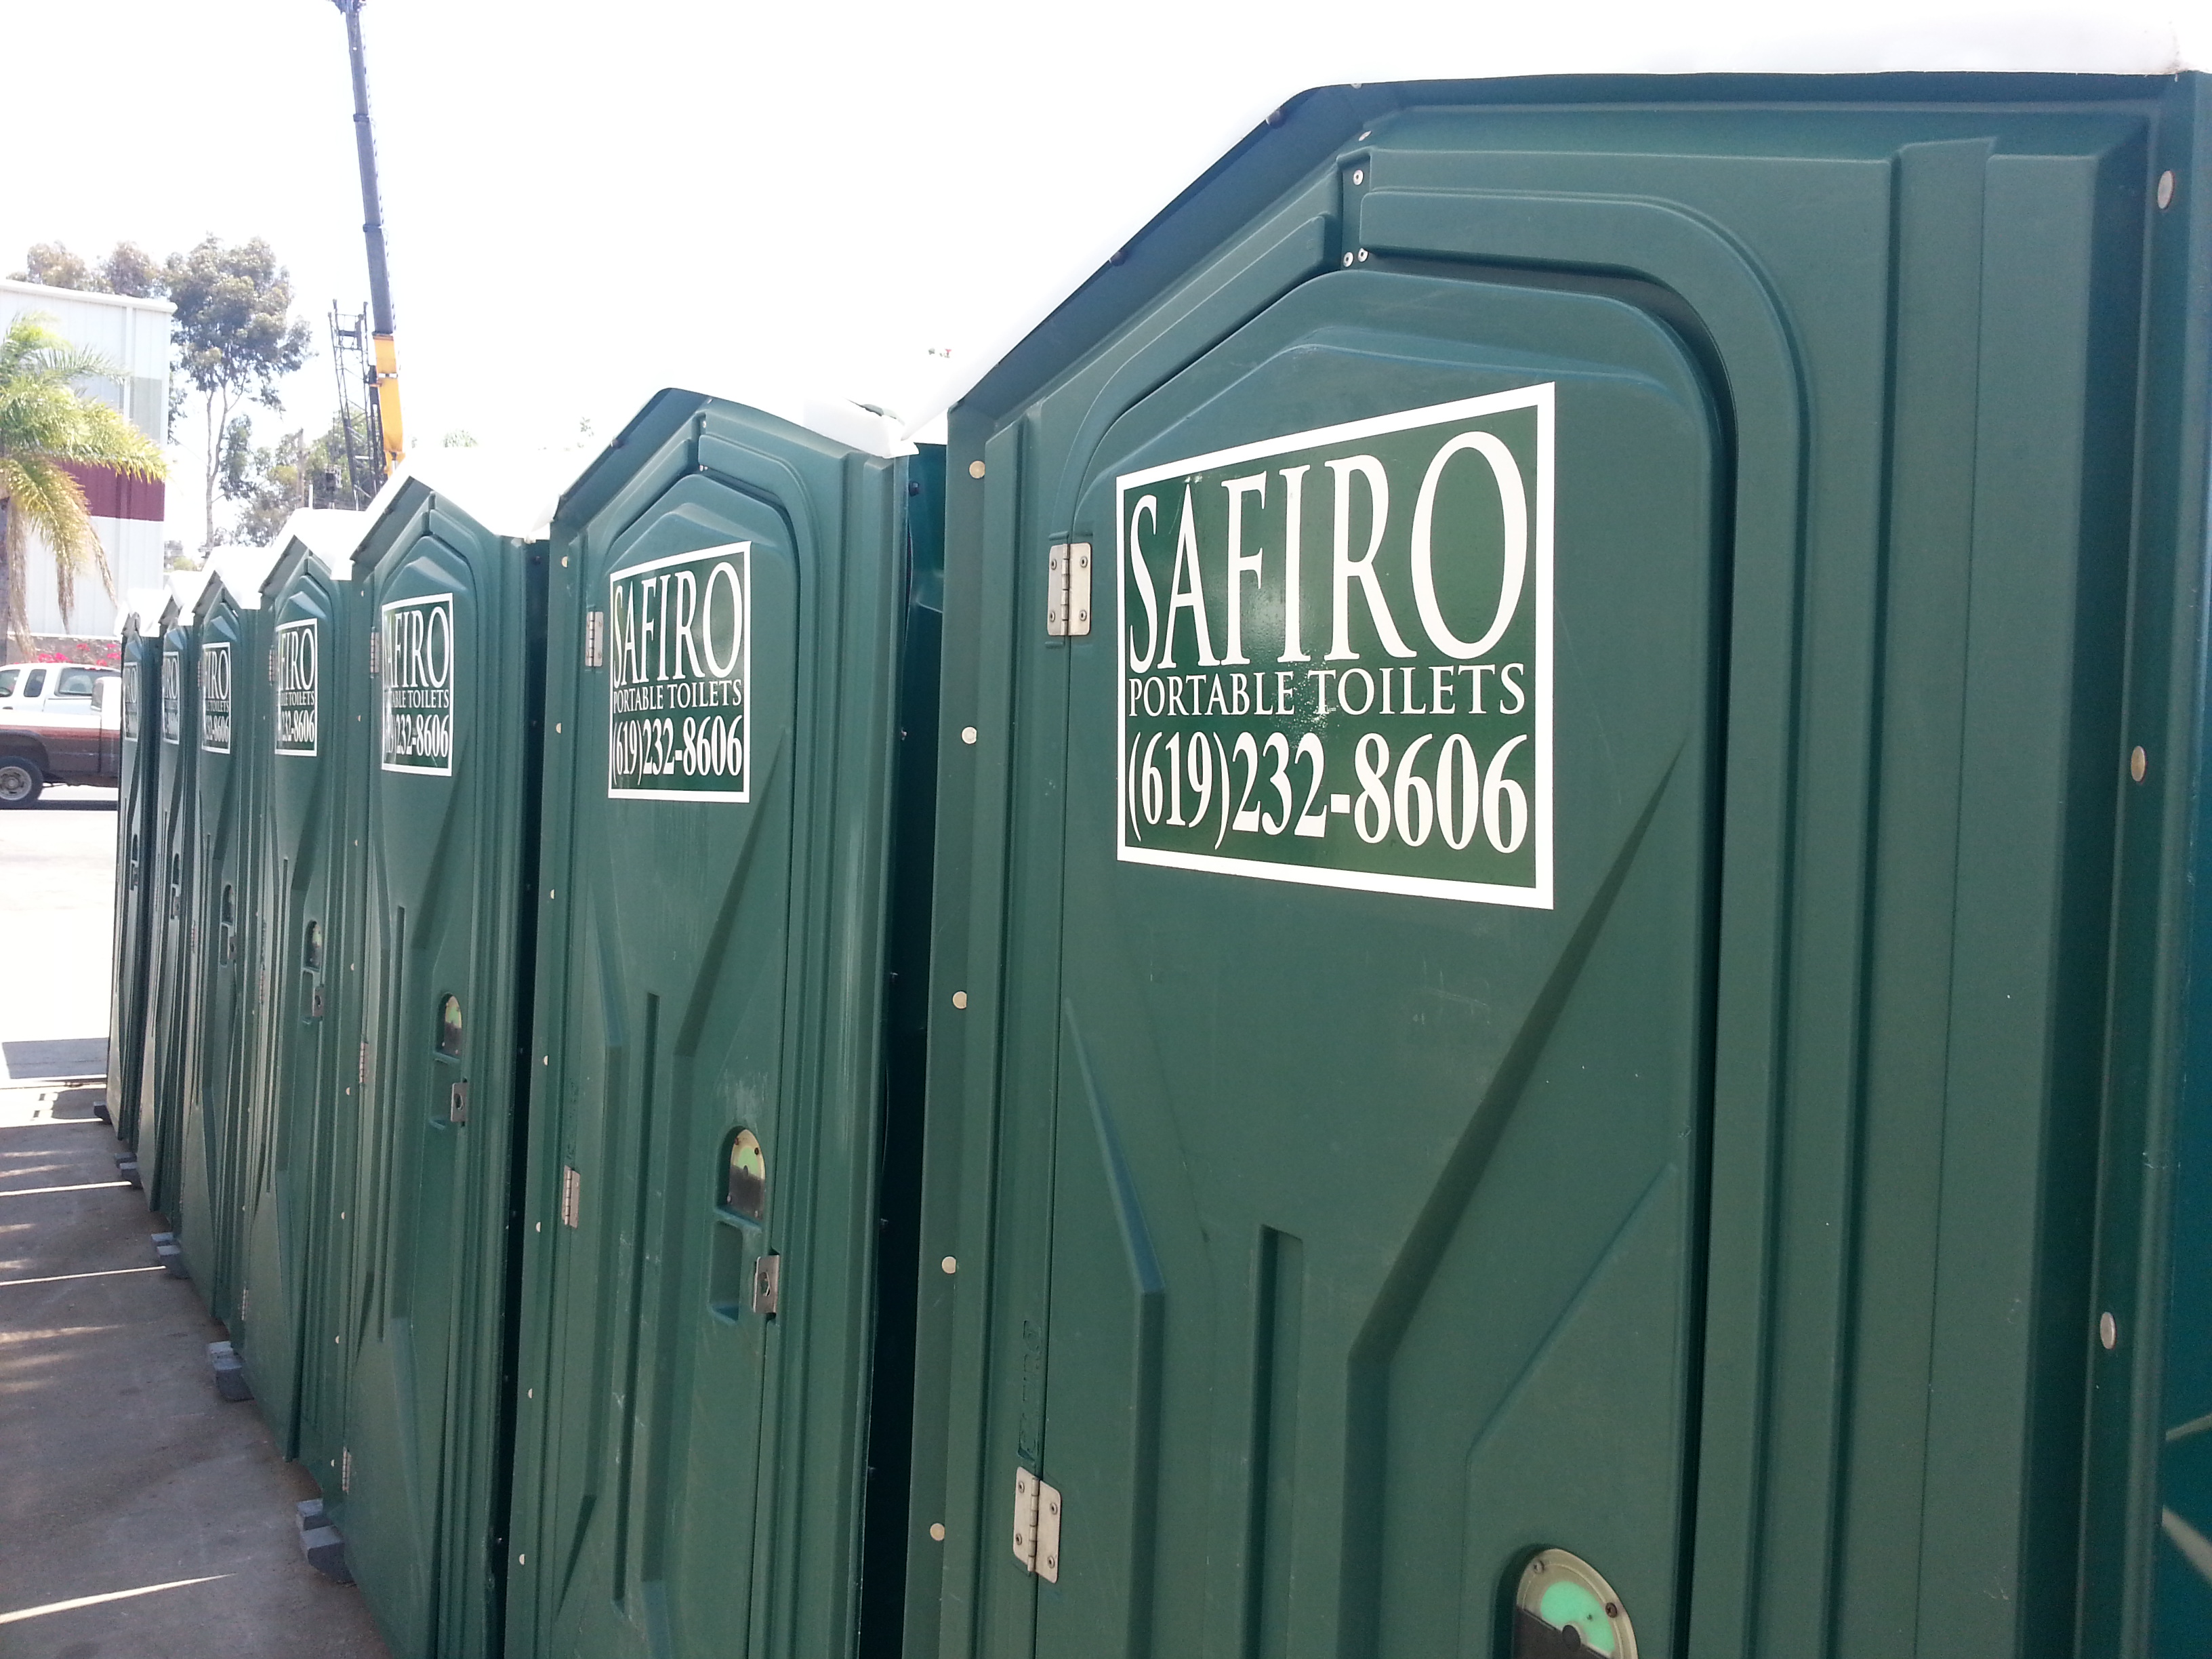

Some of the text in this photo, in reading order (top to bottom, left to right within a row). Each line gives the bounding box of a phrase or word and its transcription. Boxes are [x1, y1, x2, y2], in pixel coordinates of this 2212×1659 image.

[1129, 431, 1528, 674] SAFIRO
[613, 562, 743, 689] SAFIRO
[289, 691, 314, 705] TOILETS
[408, 689, 449, 708] TOILETS
[613, 679, 742, 714] PORTABLE TOILETS
[1129, 663, 1525, 717] PORTABLE TOILETS
[613, 715, 743, 785] (619)232-8606
[1128, 731, 1528, 854] (619)232-8606
